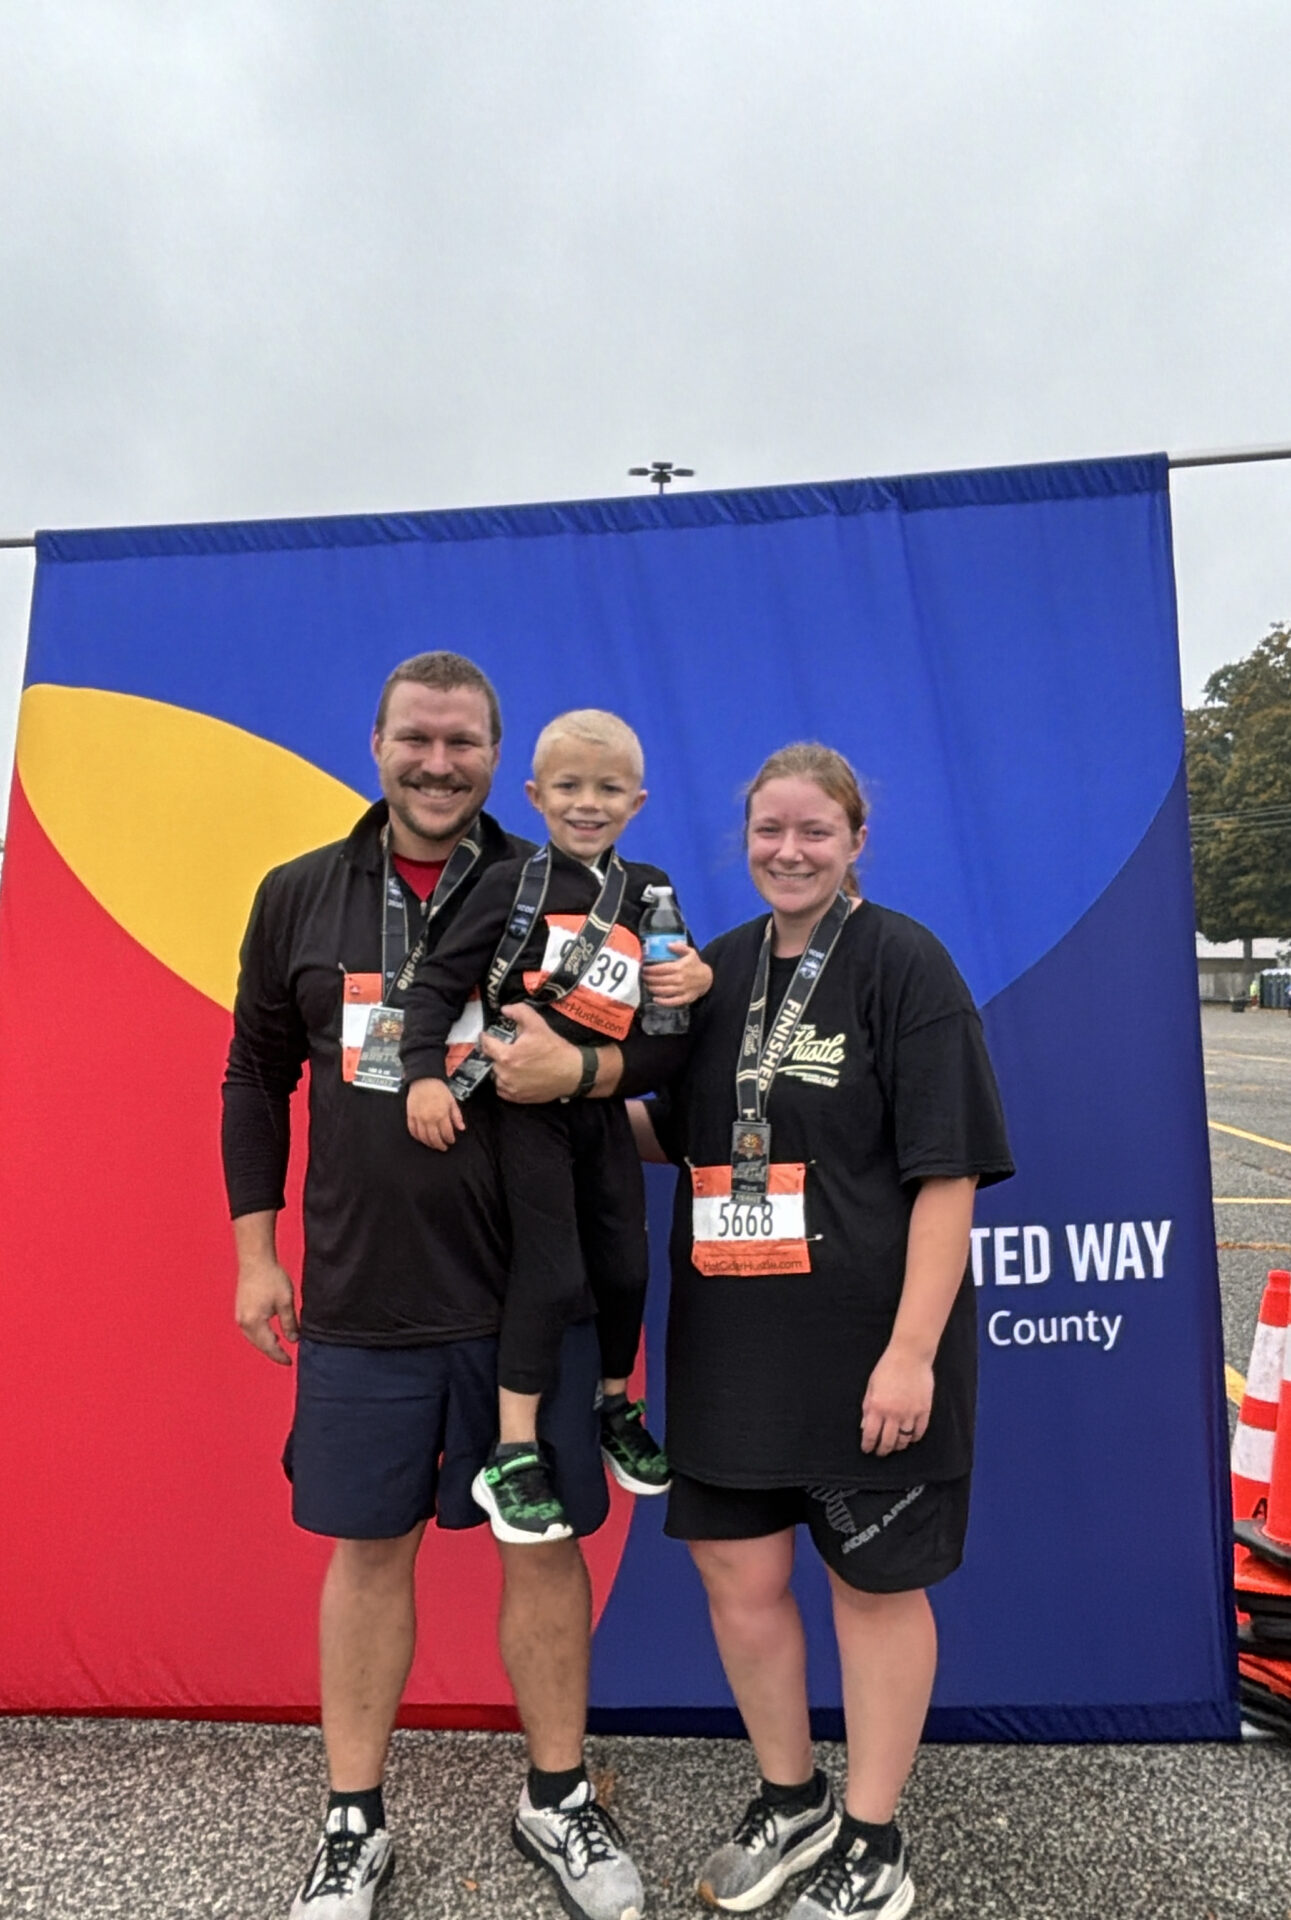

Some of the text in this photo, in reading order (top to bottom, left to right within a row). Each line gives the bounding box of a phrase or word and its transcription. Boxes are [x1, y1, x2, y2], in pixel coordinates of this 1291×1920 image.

[783, 1029, 846, 1065] Hustle
[717, 1200, 774, 1237] 5668
[969, 1219, 1172, 1287] TED WAY
[988, 1309, 1123, 1351] County
